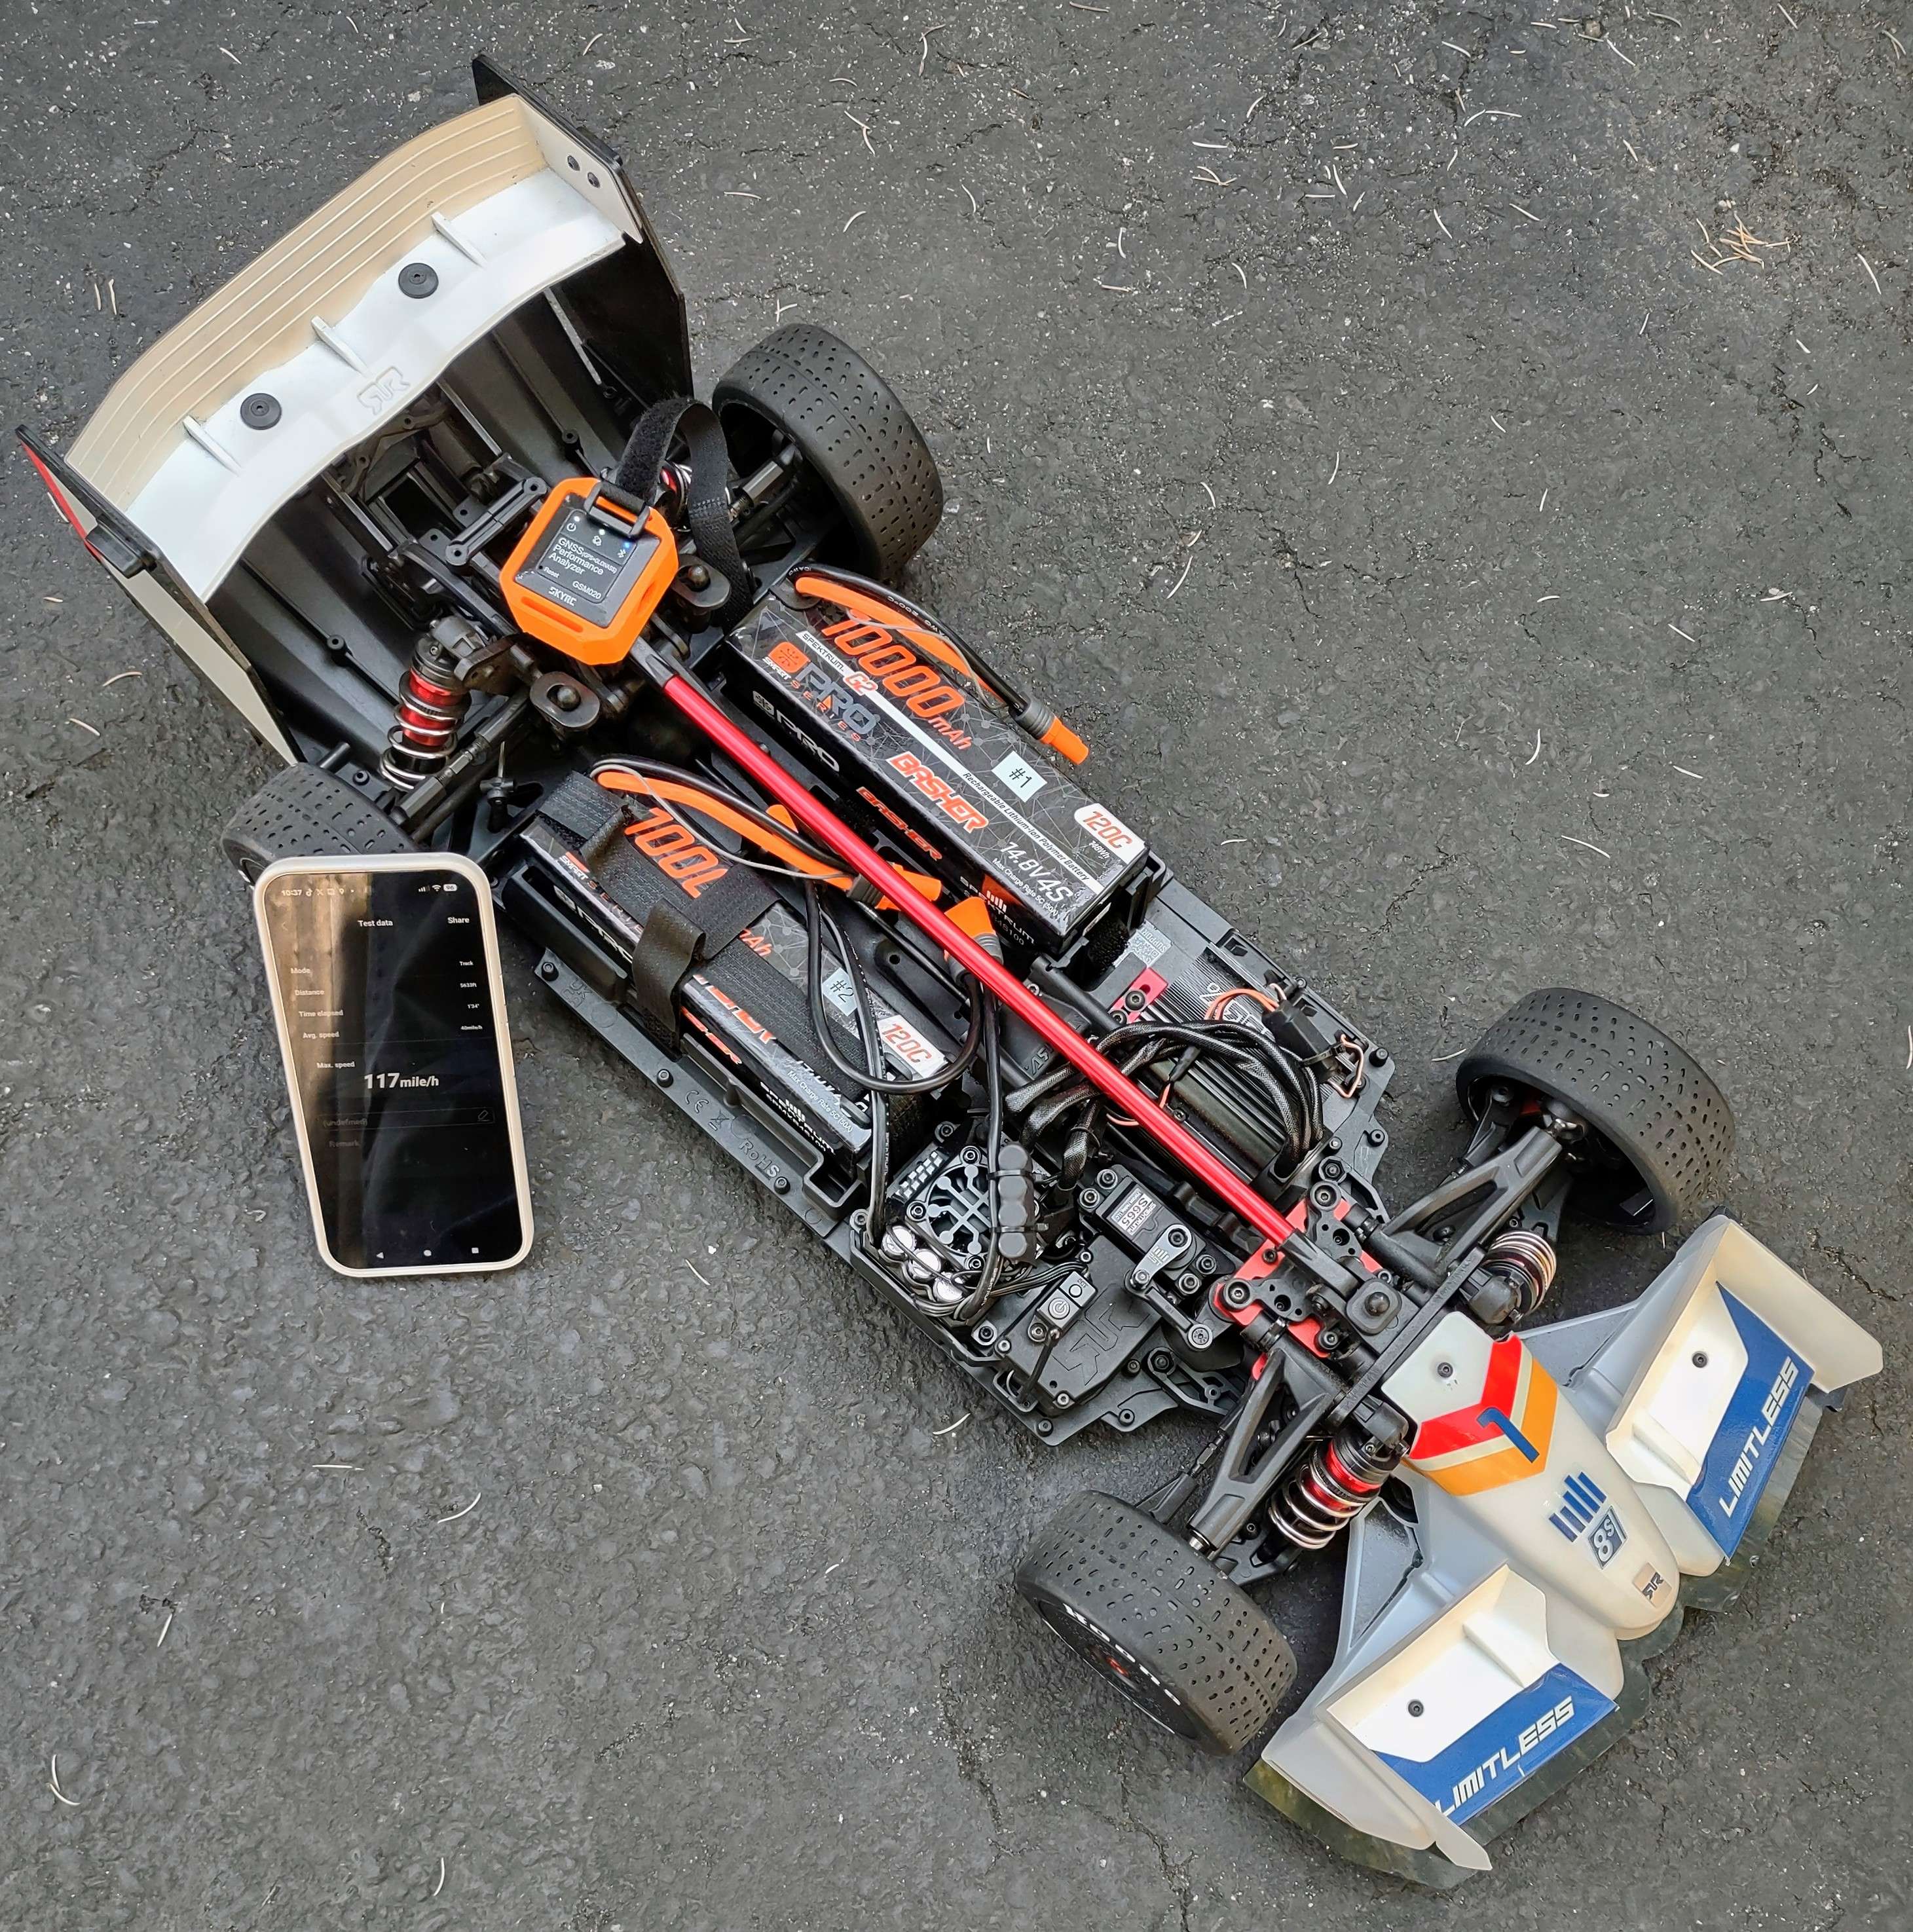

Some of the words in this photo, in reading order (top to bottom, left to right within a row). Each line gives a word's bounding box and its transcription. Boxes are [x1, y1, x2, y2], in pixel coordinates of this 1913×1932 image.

[544, 567, 560, 578] Reset
[549, 553, 585, 575] Analyzer
[553, 544, 604, 575] Performance
[548, 586, 577, 606] SKYRC
[572, 581, 601, 599] GSM020
[762, 657, 792, 680] SMART
[802, 633, 842, 672] SPEKTRUM
[794, 662, 877, 735] PRO
[821, 609, 965, 718] 10000
[928, 716, 972, 750] mAh
[844, 671, 878, 696] G2
[790, 680, 861, 741] SERIES
[776, 709, 840, 773] PRO
[886, 751, 989, 834] BASHER
[1009, 768, 1032, 789] #1
[855, 787, 942, 862] BASHER
[963, 773, 1006, 809] Rechargeable
[1003, 808, 1039, 840] Lithium-Ion
[1039, 838, 1066, 863] Polymer
[1064, 858, 1090, 881] Battery
[1081, 810, 1132, 850] 120C
[559, 855, 589, 880] SMART
[992, 858, 1005, 871] Max
[1005, 868, 1023, 887] Charge
[1023, 885, 1036, 898] Rate
[1035, 895, 1045, 904] 5C
[1001, 842, 1051, 878] 14.8V
[1037, 879, 1073, 902] 4S
[1140, 927, 1168, 952] SUPPORT
[830, 980, 854, 1003] #2
[317, 1009, 344, 1018] elapsed
[882, 1023, 933, 1063] 120C
[787, 1070, 799, 1083] Max
[800, 1081, 819, 1101] Charge
[819, 1099, 832, 1112] Rate
[830, 1109, 840, 1119] 5C
[838, 1116, 853, 1132] (50A)
[739, 1138, 781, 1178] RoHS
[1120, 1197, 1149, 1227] S665
[1718, 1354, 1798, 1519] LIMITLESS
[1435, 1696, 1574, 1817] LIMITLESS
